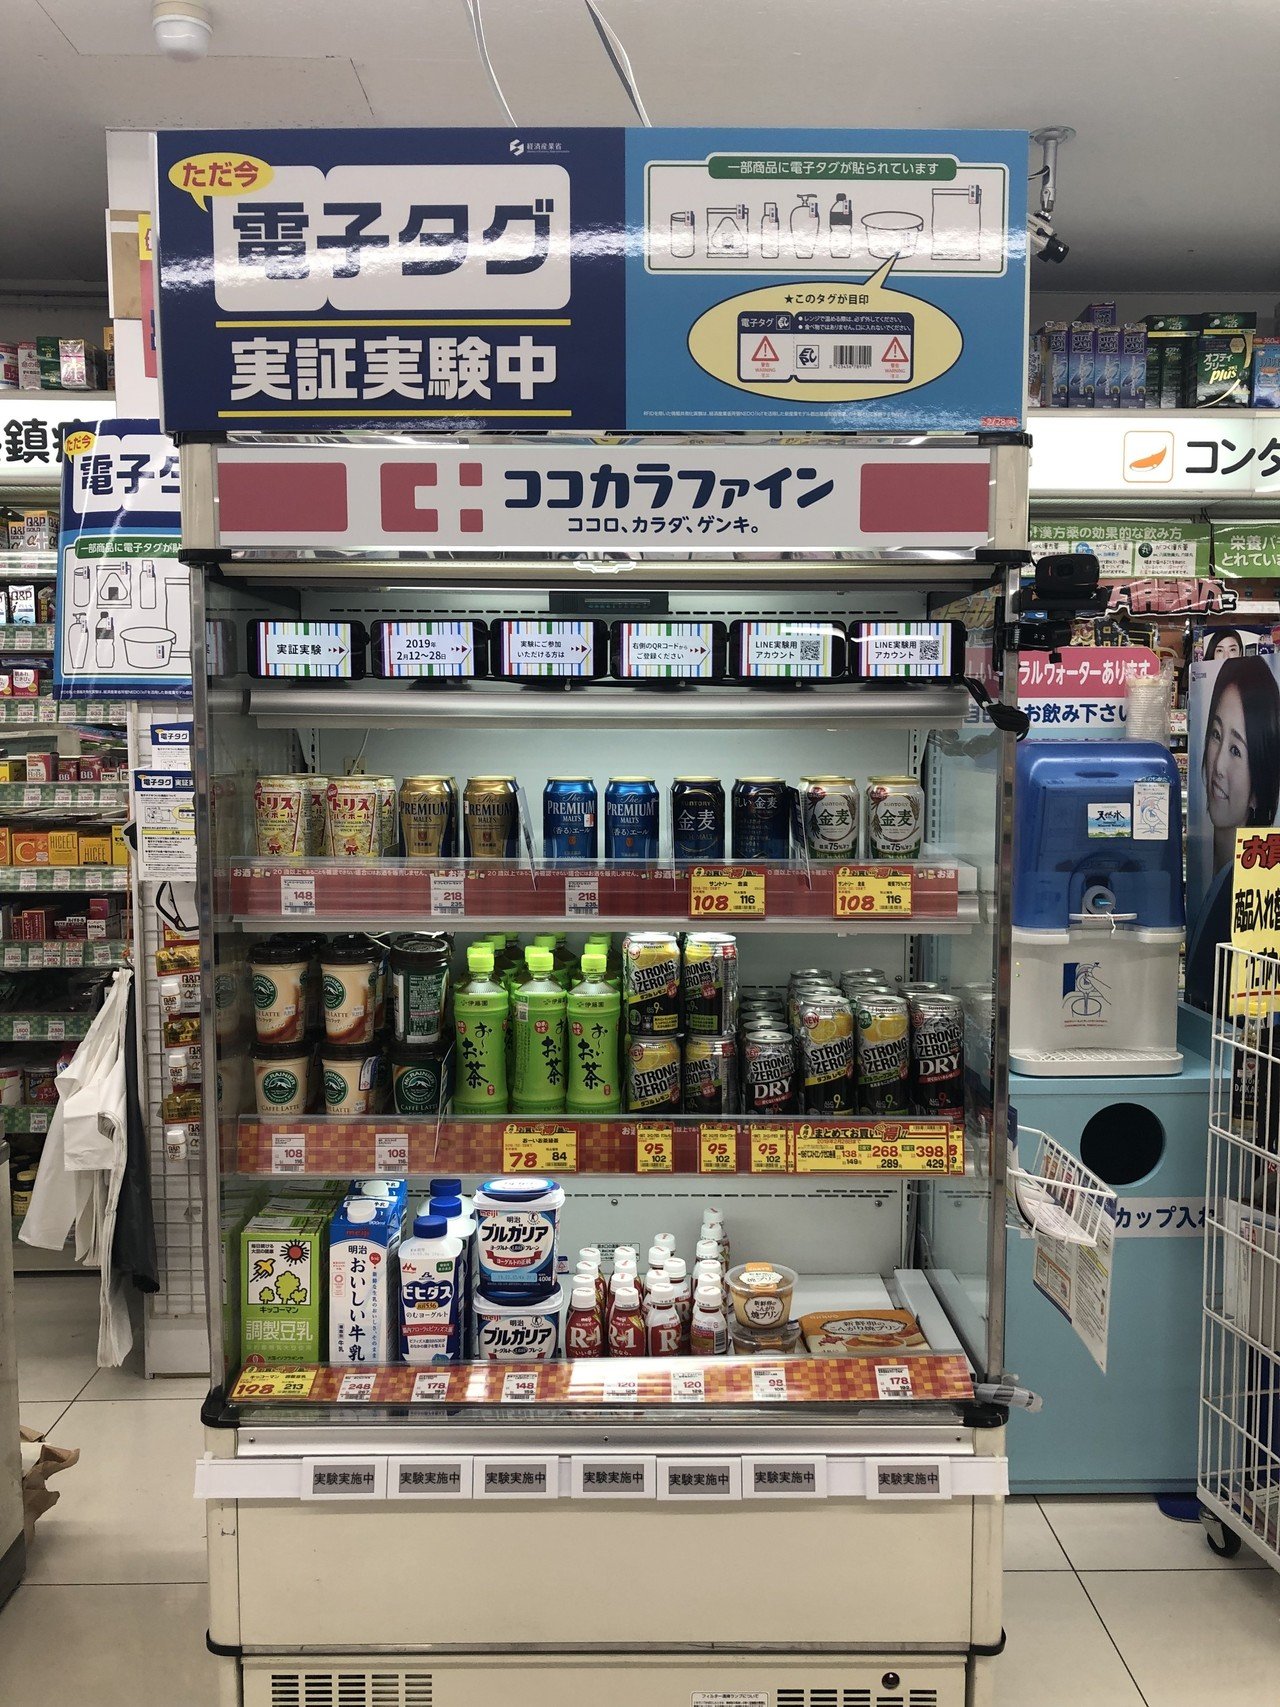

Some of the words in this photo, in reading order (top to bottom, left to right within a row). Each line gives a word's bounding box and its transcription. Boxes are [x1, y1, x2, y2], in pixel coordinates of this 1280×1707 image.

[182, 161, 259, 188] ただ今
[727, 160, 940, 176] 一部商品に電子タグが貼られています
[232, 198, 554, 279] 電子タグ
[741, 318, 774, 328] 電子タグ
[230, 335, 557, 401] 実証実験中
[1208, 369, 1237, 384] plus
[66, 435, 92, 451] ただ今
[504, 463, 835, 509] ココカラファイン
[568, 516, 759, 533] ココロ、カラダ、ゲンキ。
[276, 644, 322, 655] 実証実験
[406, 639, 436, 648] 2019年
[520, 640, 562, 649] 実験にご参加
[755, 641, 798, 650] LINE実験用
[875, 641, 917, 650] LINE実験用
[517, 650, 565, 659] いただける方は
[636, 652, 684, 660] ご登録ください
[756, 651, 795, 659] アカウント
[875, 651, 914, 659] アカウント
[160, 732, 189, 740] 電子タグ
[143, 777, 172, 786] 電子タグ
[332, 798, 370, 811] トリス
[400, 800, 449, 816] PREMIUM
[547, 800, 595, 815] PREMIUM
[607, 802, 654, 816] PREMIUM
[755, 797, 778, 809] 金麦
[677, 809, 715, 832] 金麦
[818, 809, 850, 827] 金麦
[880, 810, 912, 827] 金麦
[1095, 810, 1126, 821] 天然水
[233, 869, 251, 877] お酒
[443, 892, 462, 900] 218
[578, 892, 597, 900] 218
[740, 895, 755, 904] 116
[886, 895, 902, 904] 116
[693, 895, 729, 911] 108
[839, 895, 875, 911] 108
[634, 960, 674, 981] STRONG
[637, 976, 665, 993] ZERO
[916, 1027, 961, 1046] STRONG
[811, 1037, 853, 1062] STRONG
[864, 1037, 907, 1061] STRONG
[917, 1043, 947, 1058] ZERO
[462, 1038, 489, 1089] お茶
[542, 1036, 564, 1085] お茶
[578, 1038, 605, 1090] お茶
[752, 1055, 790, 1072] STRONG
[813, 1055, 847, 1074] ZERO
[866, 1057, 899, 1074] ZERO
[919, 1052, 961, 1075] DRY
[634, 1062, 677, 1086] STRONG
[752, 1068, 780, 1082] ZERO
[637, 1081, 667, 1099] ZERO
[754, 1077, 792, 1099] DRY
[284, 1149, 303, 1158] 108
[387, 1149, 406, 1158] 108
[644, 1143, 664, 1155] 95
[708, 1143, 728, 1155] 95
[758, 1143, 778, 1155] 95
[841, 1150, 857, 1158] 138
[872, 1145, 899, 1158] 268
[915, 1145, 944, 1158] 398
[509, 1152, 538, 1168] 78
[552, 1151, 567, 1161] 84
[880, 1158, 899, 1168] 289
[926, 1158, 944, 1168] 429
[346, 1229, 370, 1237] meiji
[482, 1224, 549, 1243] ブルガリア
[348, 1245, 367, 1254] 明治
[403, 1285, 452, 1300] ビヒダス
[260, 1306, 299, 1314] キッコーマン
[348, 1257, 366, 1361] おいしい牛乳
[406, 1311, 449, 1319] のむヨーグルト
[750, 1311, 780, 1321] 焼プリン
[246, 1320, 313, 1341] 調製豆乳
[484, 1327, 552, 1345] ブルガリア
[768, 1379, 784, 1387] 98
[889, 1376, 909, 1385] 178
[237, 1384, 275, 1394] 198
[314, 1472, 375, 1486] 実験実施中
[400, 1471, 460, 1485] 実験実施中
[486, 1471, 546, 1485] 実験実施中
[584, 1471, 644, 1484] 実験実施中
[669, 1473, 729, 1486] 実験実施中
[755, 1471, 815, 1484] 実験実施中
[878, 1472, 938, 1485] 実験実施中
